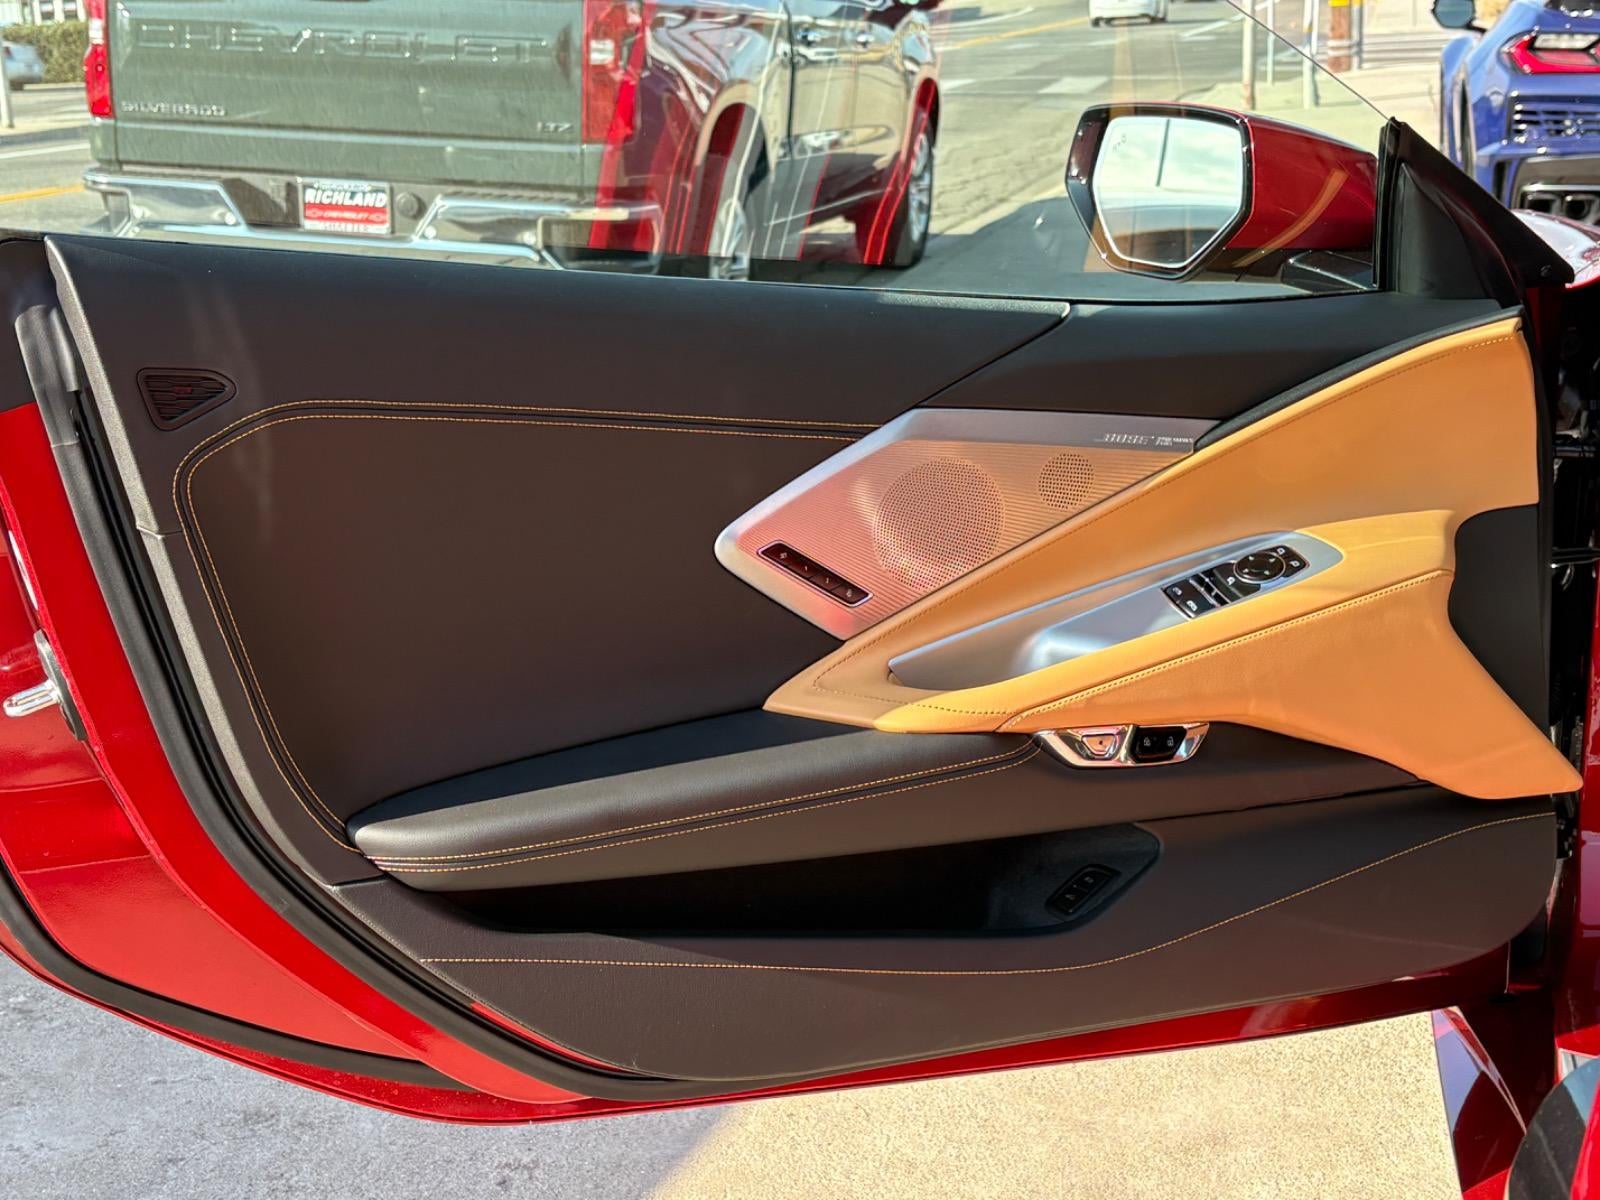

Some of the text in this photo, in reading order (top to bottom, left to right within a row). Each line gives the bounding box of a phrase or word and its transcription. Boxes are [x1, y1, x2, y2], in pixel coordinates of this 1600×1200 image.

[136, 24, 546, 64] CHEVROLET
[121, 101, 226, 116] SILVERADO
[304, 187, 387, 208] RICHLAND
